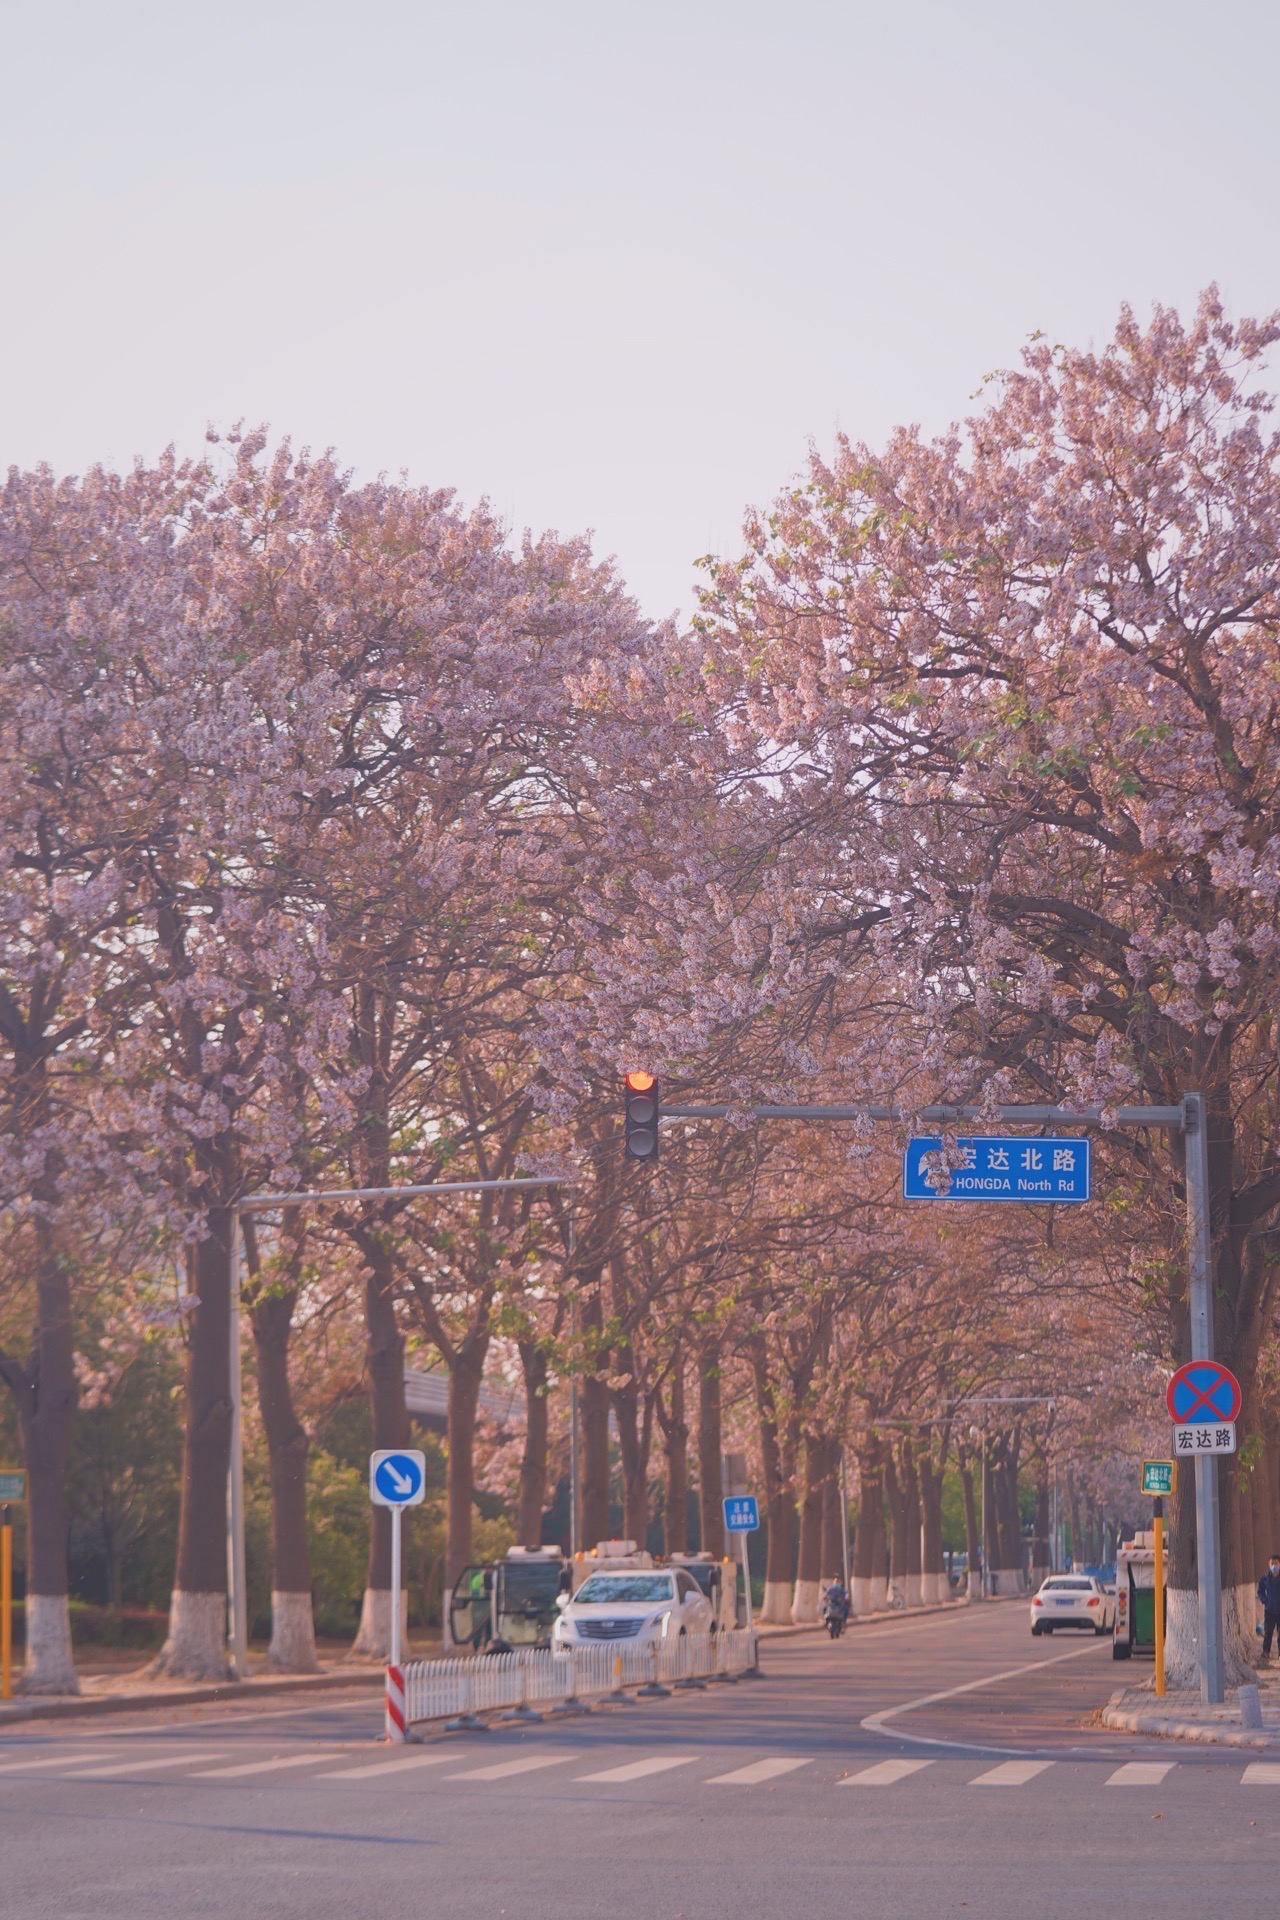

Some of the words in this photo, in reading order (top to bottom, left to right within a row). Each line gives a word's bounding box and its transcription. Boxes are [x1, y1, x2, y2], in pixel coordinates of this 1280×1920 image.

[956, 1177, 1011, 1190] HONGDA
[1017, 1179, 1052, 1191] North
[1058, 1180, 1074, 1192] Rd
[1178, 1428, 1231, 1449] 宏达路
